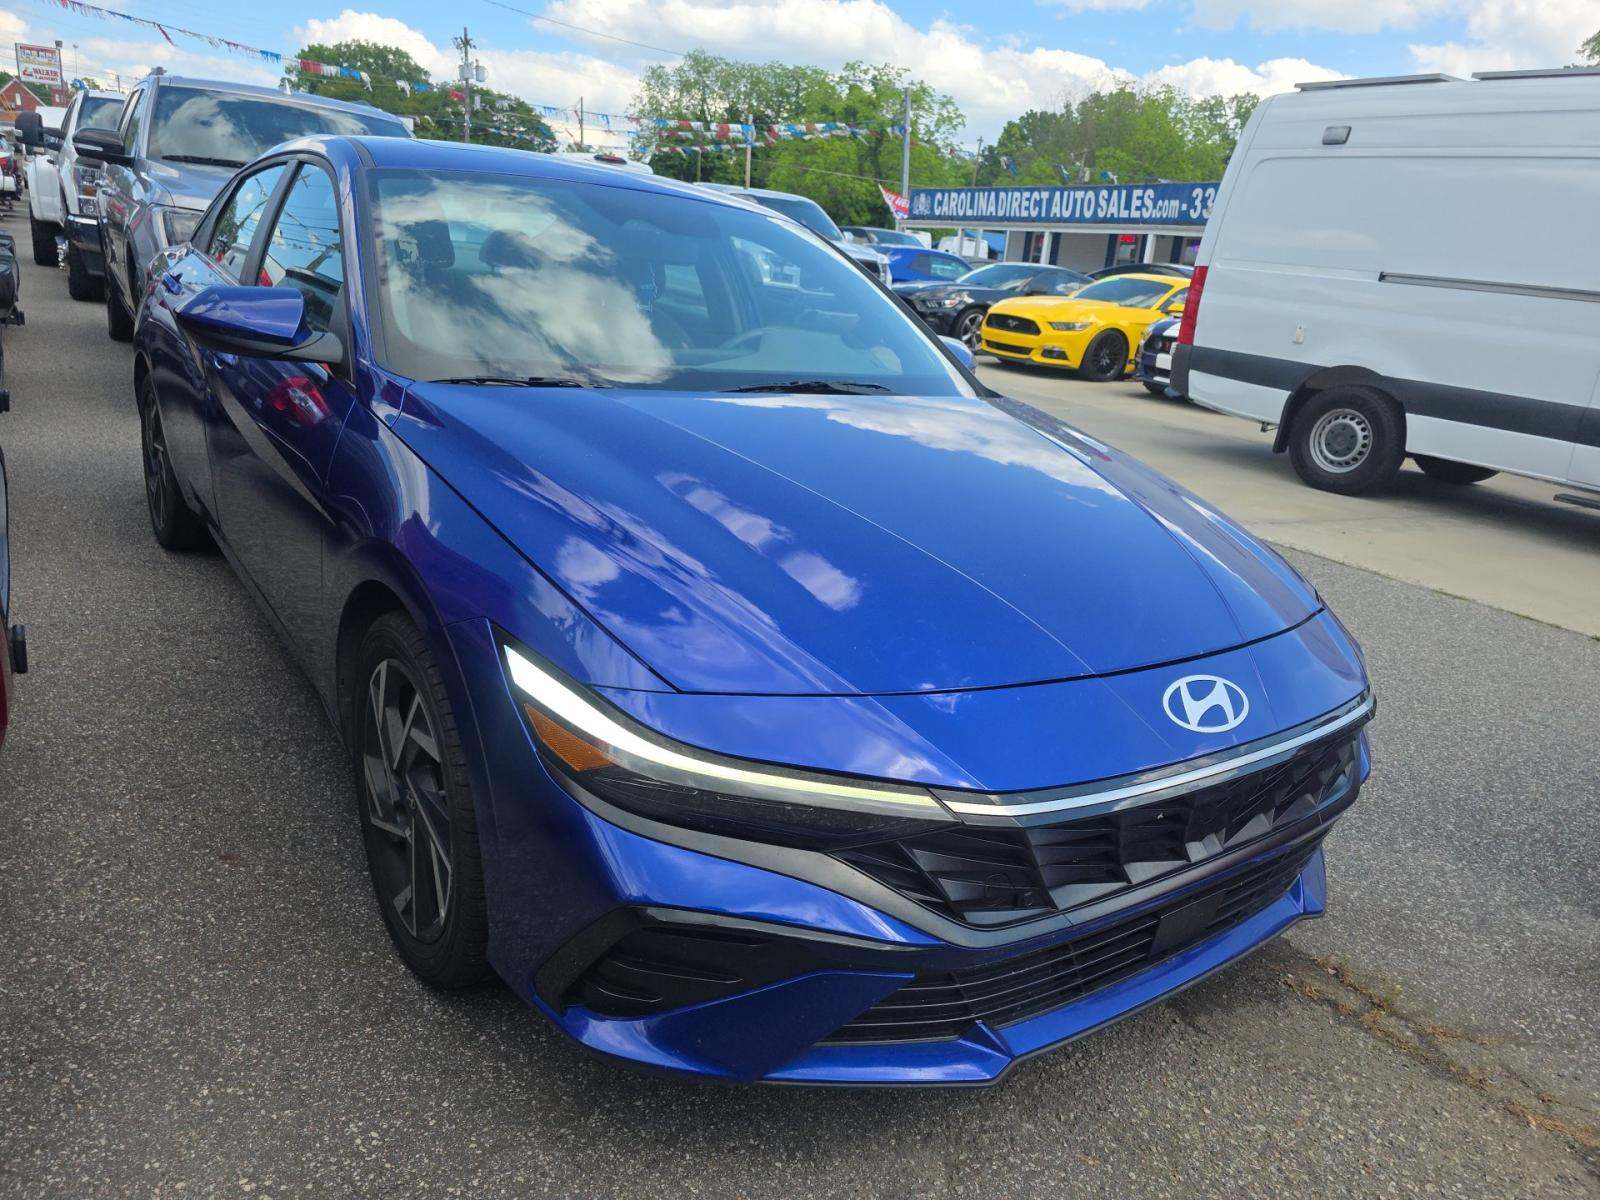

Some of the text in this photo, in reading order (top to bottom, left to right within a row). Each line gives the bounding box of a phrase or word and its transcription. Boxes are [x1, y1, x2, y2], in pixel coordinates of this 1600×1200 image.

[934, 191, 996, 216] CAROLINA
[998, 191, 1050, 218] DIRECT
[1051, 190, 1096, 218] AUTO
[1097, 188, 1180, 219] SALES.com
